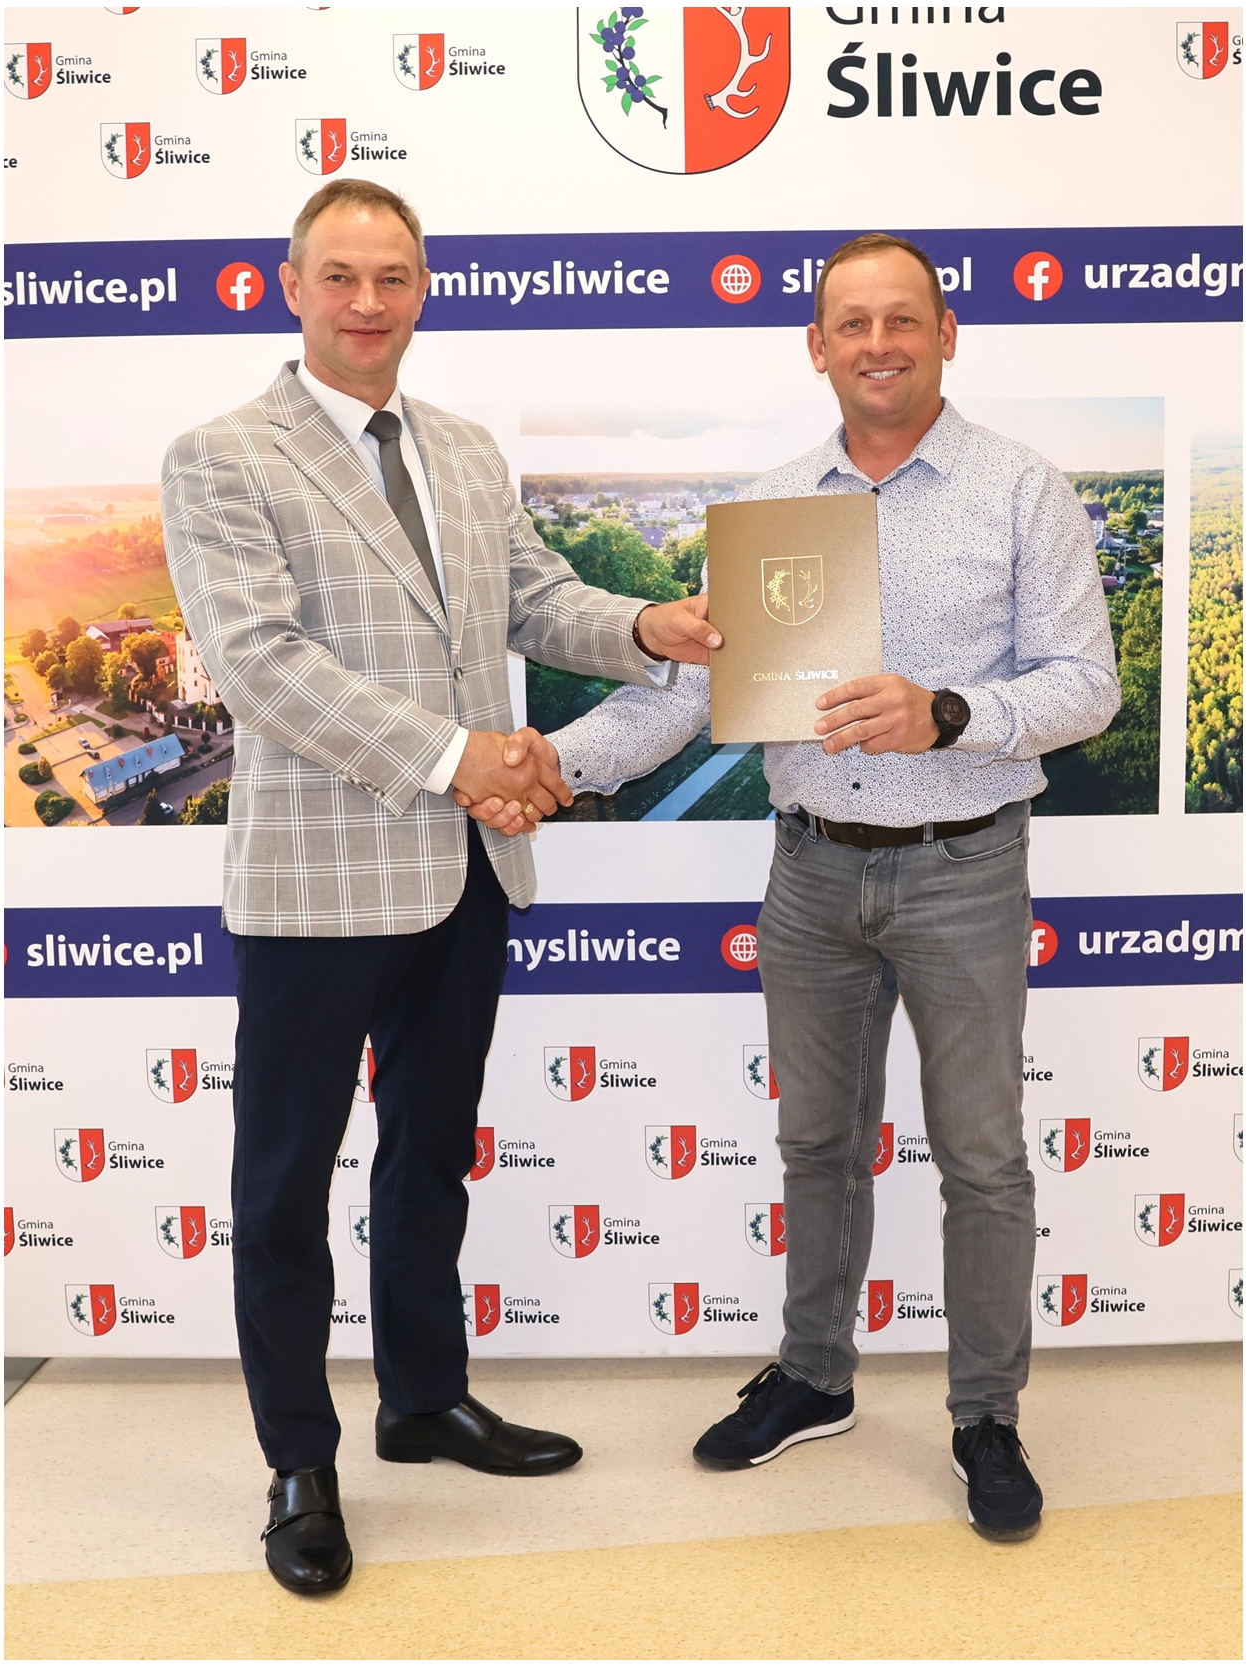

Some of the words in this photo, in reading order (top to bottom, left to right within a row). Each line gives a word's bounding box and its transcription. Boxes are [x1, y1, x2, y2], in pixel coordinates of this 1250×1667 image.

[250, 50, 288, 61] Gmina
[448, 46, 486, 57] Gmina
[55, 55, 92, 66] Gmina
[250, 65, 308, 81] Śliwice
[448, 61, 506, 77] Śliwice
[55, 69, 112, 85] Śliwice
[826, 41, 1103, 119] Śliwice
[154, 134, 191, 145] Gmina
[350, 131, 388, 142] Gmina
[154, 149, 211, 165] Śliwice
[350, 145, 408, 161] Śliwice
[424, 260, 670, 306] minysliwice
[753, 672, 791, 682] GMINA
[795, 669, 839, 681] ŚLIWICE
[26, 932, 203, 973] sliwice.pl
[1192, 1048, 1230, 1059] Gmina
[7, 1062, 44, 1073] Gmina
[599, 1059, 637, 1070] Gmina
[8, 1074, 64, 1091] Śliwice
[599, 1070, 657, 1087] Śliwice
[1093, 1129, 1131, 1140] Gmina
[107, 1140, 145, 1151] Gmina
[498, 1139, 536, 1150] Gmina
[699, 1137, 738, 1148] Gmina
[1093, 1141, 1150, 1158] Śliwice
[108, 1152, 165, 1169] Śliwice
[498, 1150, 556, 1167] Śliwice
[700, 1149, 758, 1166] Śliwice
[1187, 1204, 1225, 1215] Gmina
[17, 1219, 54, 1230] Gmina
[603, 1217, 641, 1228] Gmina
[1187, 1216, 1243, 1233] Śliwice
[18, 1230, 74, 1247] Śliwice
[603, 1228, 661, 1245] Śliwice
[896, 1291, 934, 1302] Gmina
[1090, 1285, 1127, 1296] Gmina
[118, 1296, 156, 1307] Gmina
[503, 1296, 541, 1307] Gmina
[702, 1294, 740, 1305] Gmina
[1090, 1296, 1146, 1313] Śliwice
[119, 1308, 175, 1324] Śliwice
[504, 1306, 560, 1323] Śliwice
[703, 1305, 759, 1322] Śliwice
